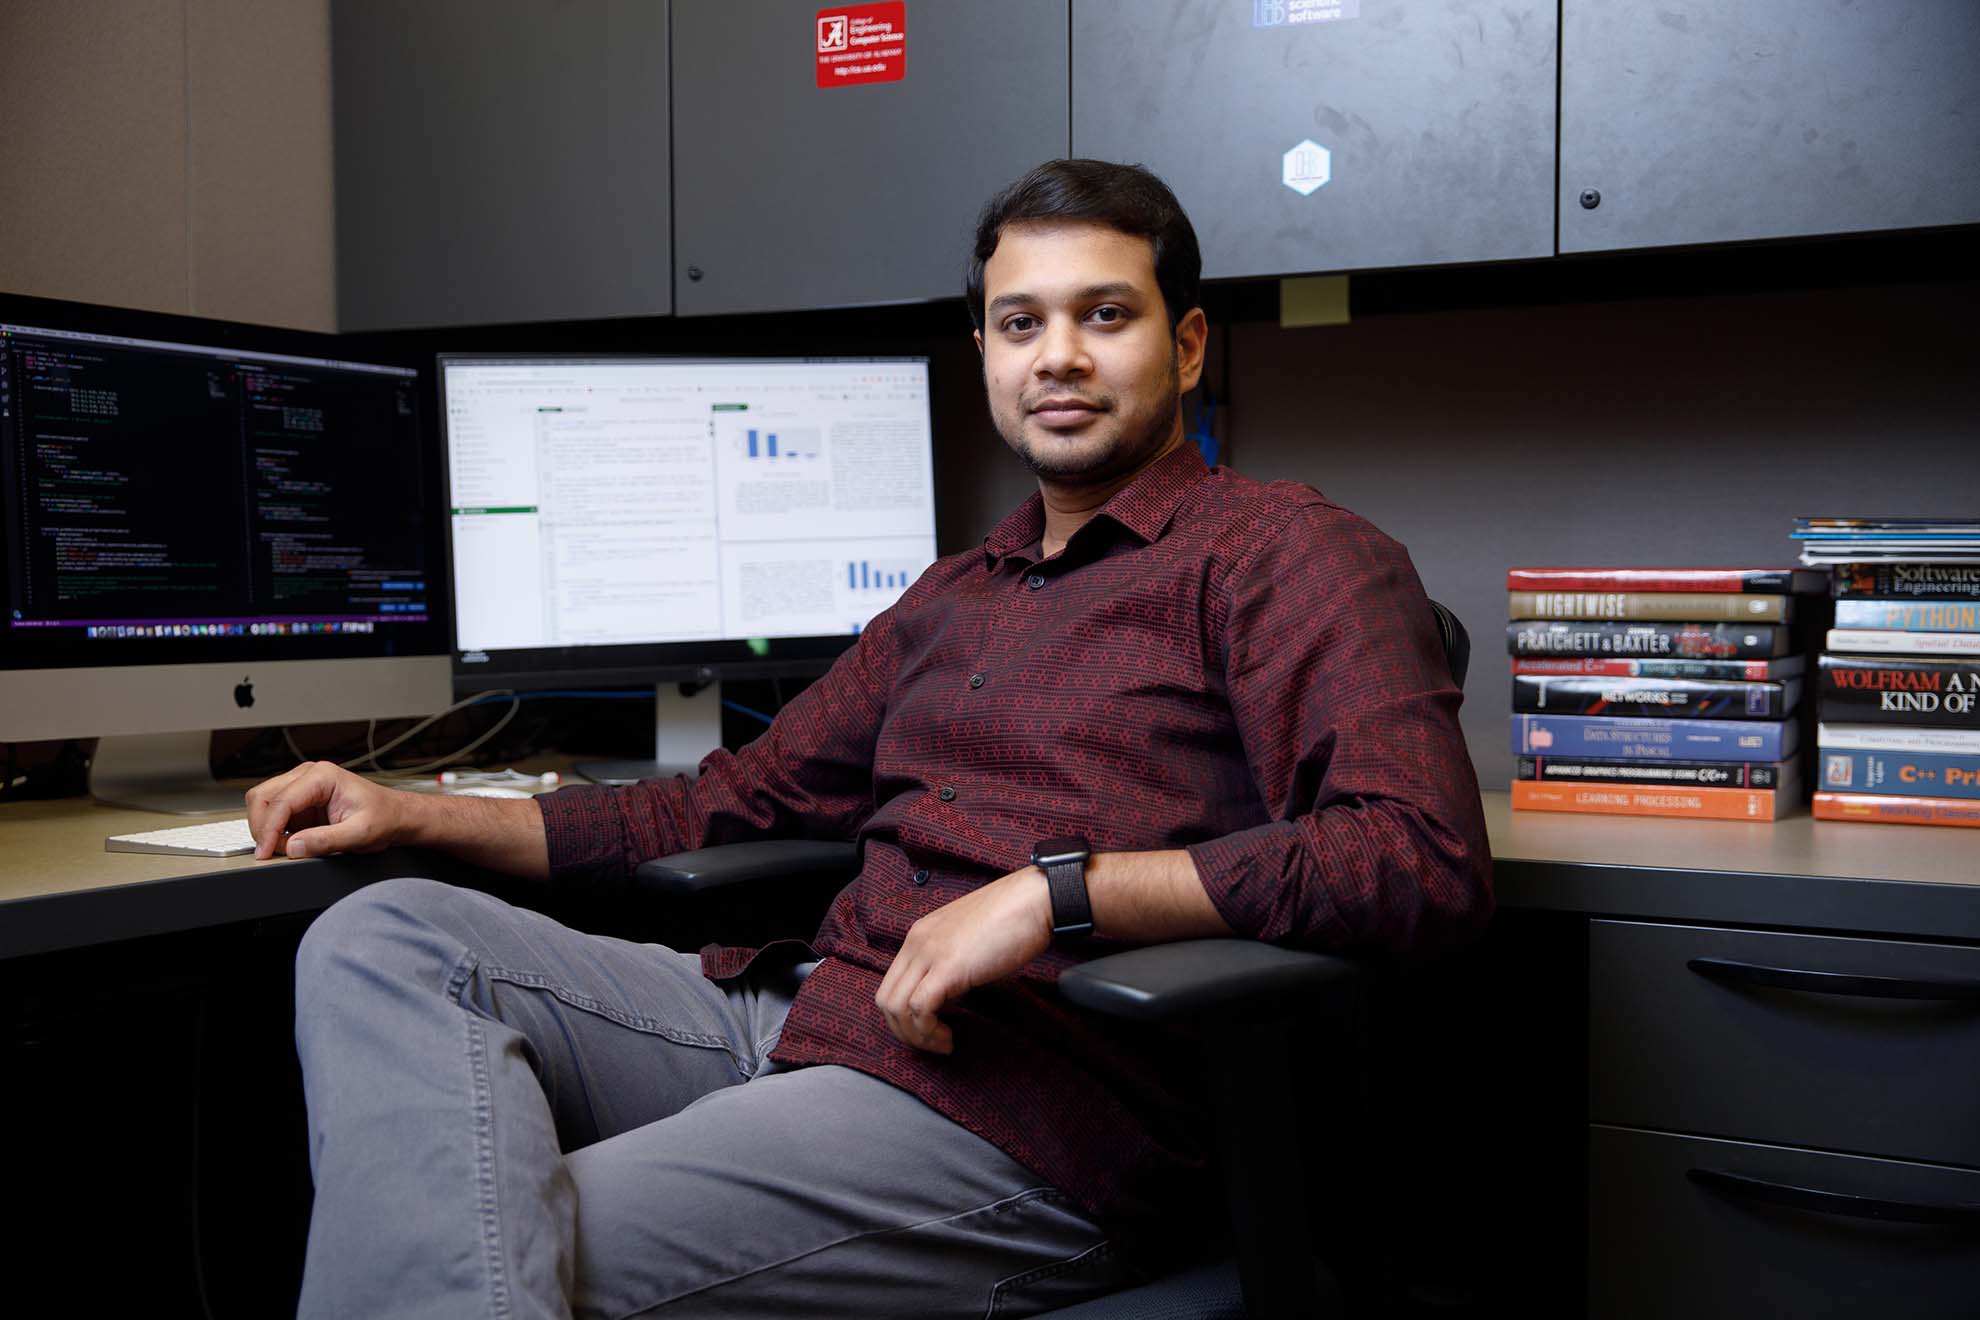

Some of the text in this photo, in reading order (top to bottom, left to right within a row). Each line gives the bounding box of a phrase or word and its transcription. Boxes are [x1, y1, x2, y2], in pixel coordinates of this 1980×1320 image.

[1288, 8, 1342, 23] software
[849, 22, 893, 36] Engineering
[849, 32, 904, 46] Computer Science
[1893, 563, 1980, 581] Software
[1535, 593, 1625, 617] NIGHTWISE
[1886, 604, 1976, 631] PYTHON
[1517, 630, 1600, 651] PRATCHETT
[1601, 638, 1612, 651] &
[1612, 633, 1670, 653] BAXTER
[1831, 668, 1942, 691] WOLFRAM
[1945, 672, 1966, 692] A
[1601, 689, 1670, 704] NETWORKS
[1879, 690, 1976, 713] KIND OF
[1544, 764, 1582, 776] ADVANCED
[1898, 764, 1936, 783] C++
[1575, 791, 1630, 807] LEARNING
[1632, 793, 1702, 809] PROCESSING
[1879, 803, 1932, 820] Working
